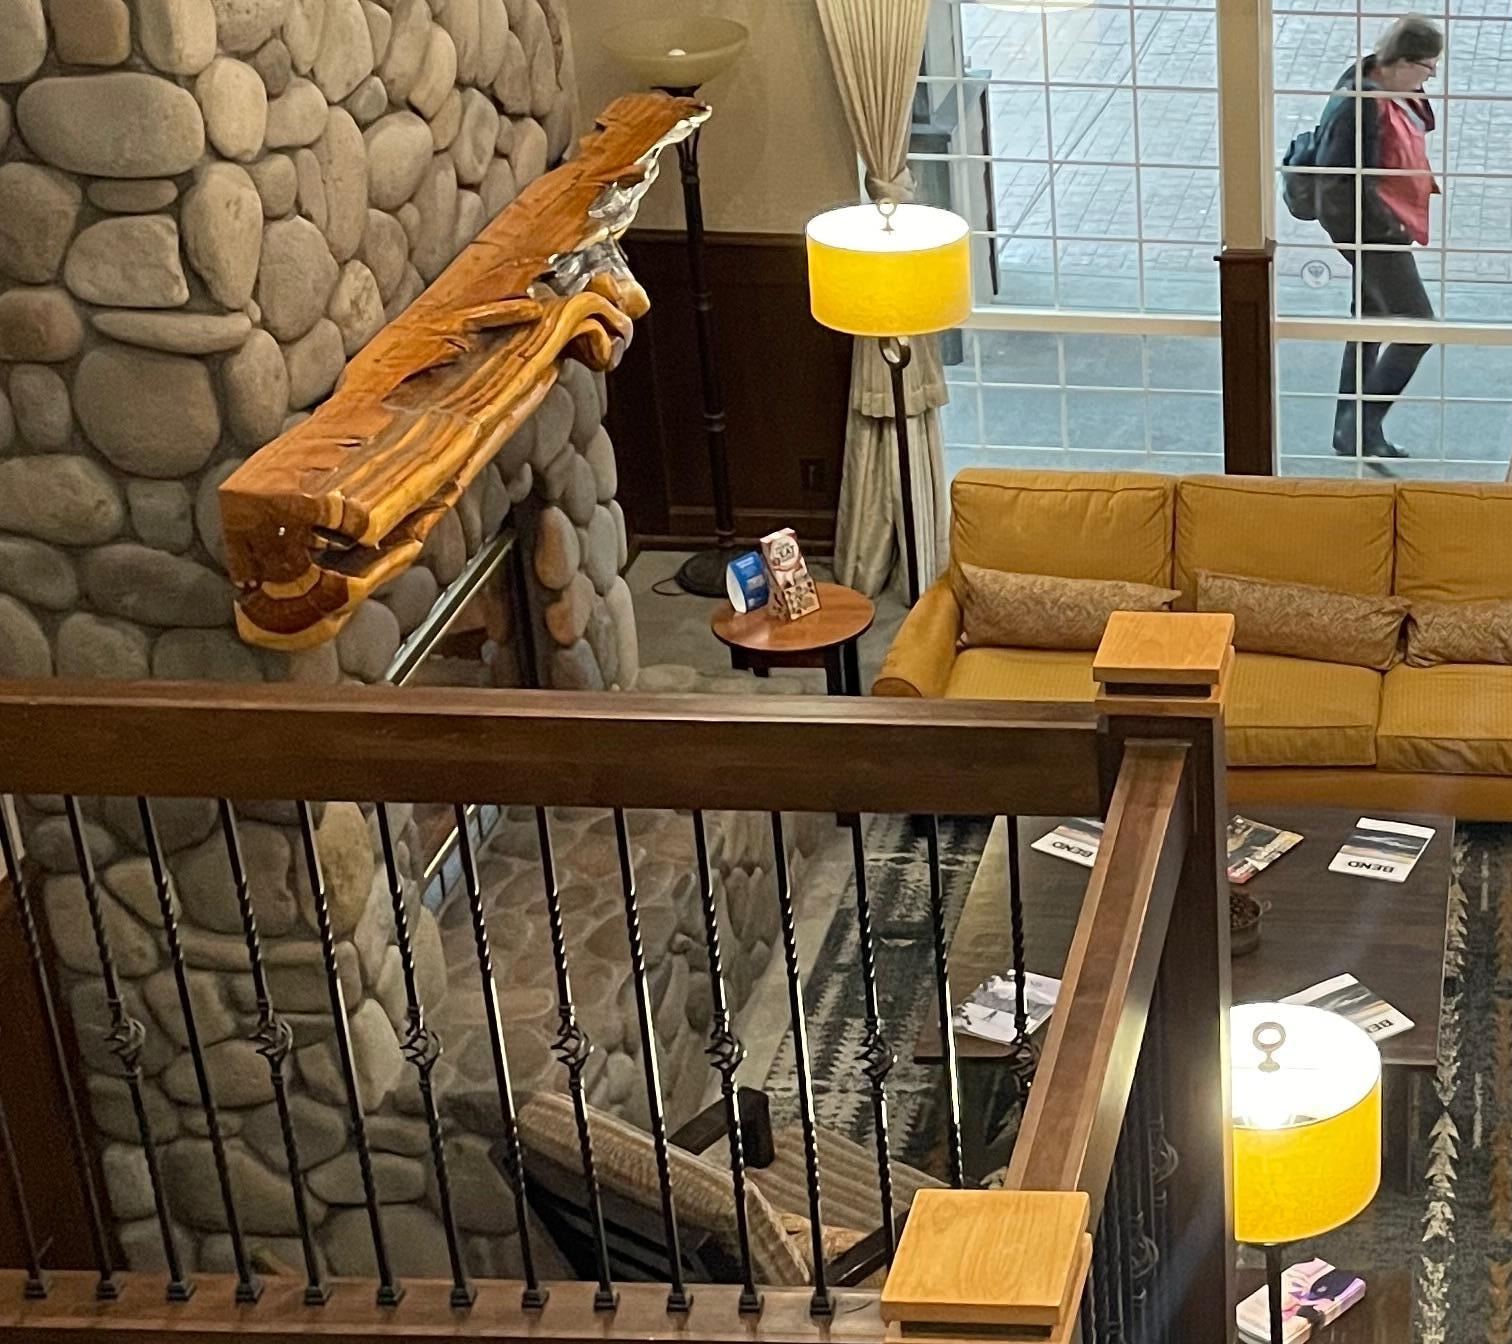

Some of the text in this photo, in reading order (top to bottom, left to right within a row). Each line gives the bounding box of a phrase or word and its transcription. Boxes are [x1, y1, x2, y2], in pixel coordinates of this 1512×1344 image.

[1052, 841, 1094, 858] BEND
[1347, 860, 1396, 874] BEND
[1364, 1019, 1394, 1034] BE
